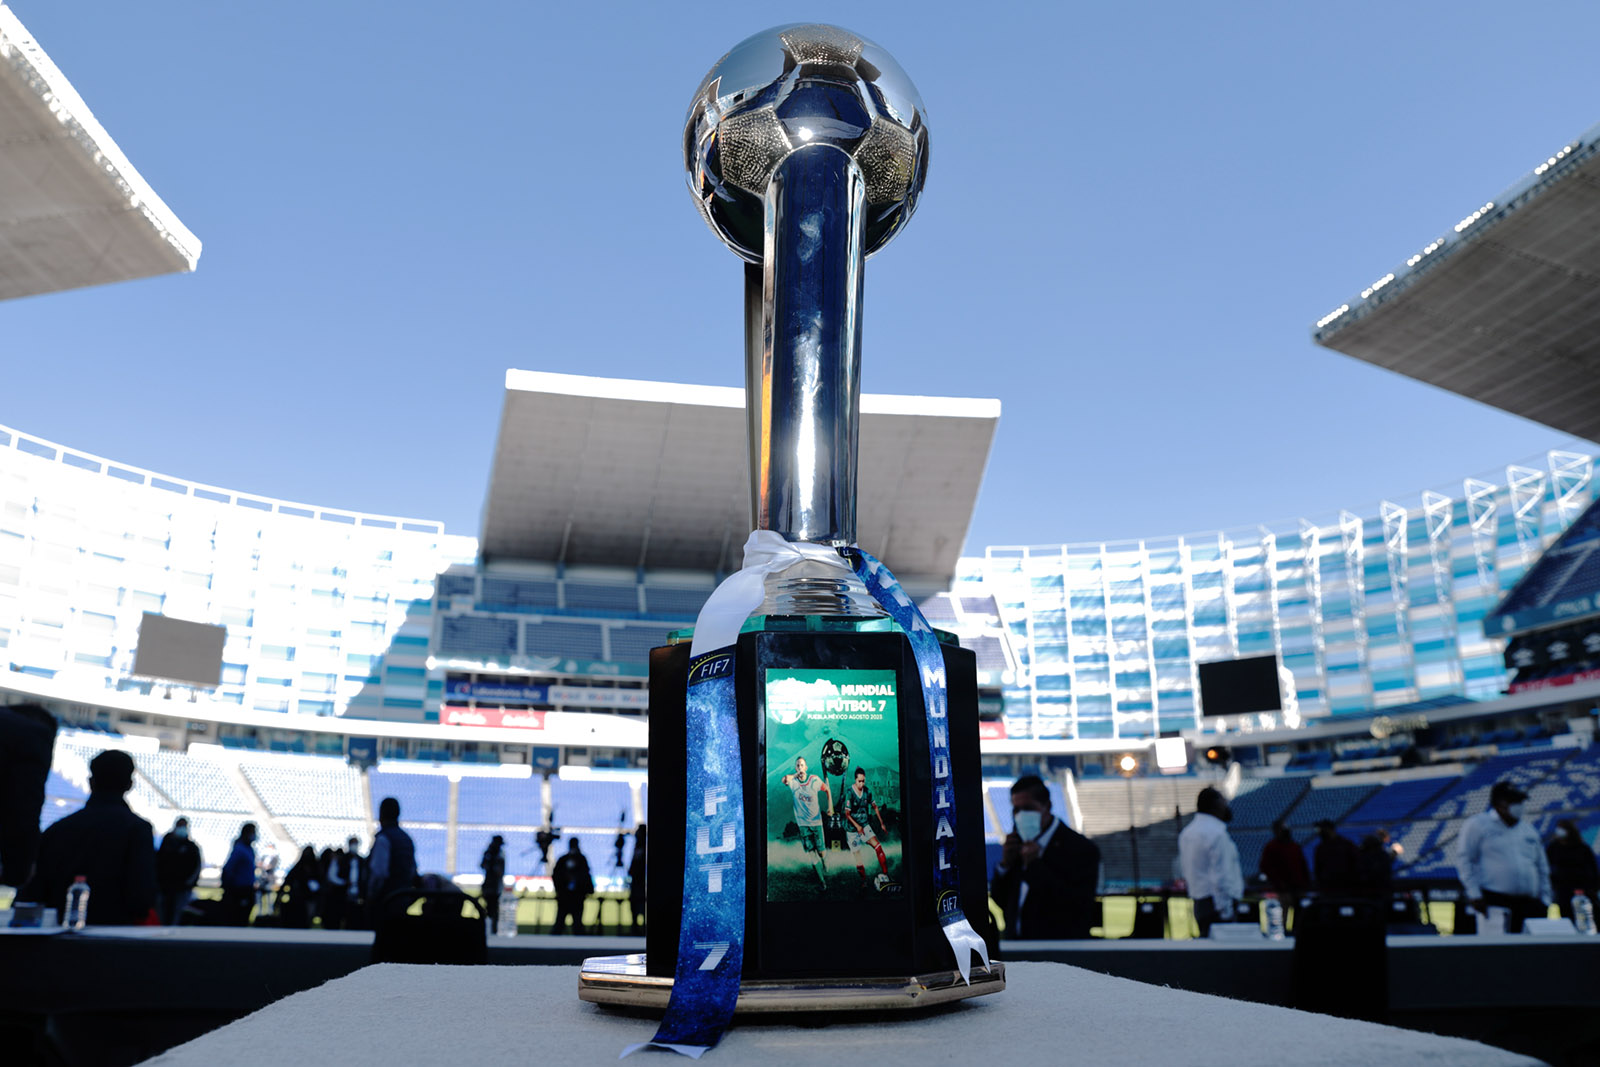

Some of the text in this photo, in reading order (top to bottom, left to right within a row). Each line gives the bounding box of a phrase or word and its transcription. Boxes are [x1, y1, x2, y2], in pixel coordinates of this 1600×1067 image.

[701, 658, 730, 677] FIF7
[841, 684, 895, 696] MUNDIAL
[826, 697, 876, 712] FÚTBOL
[878, 700, 887, 712] 7
[922, 665, 955, 871] MUNDIAL
[694, 785, 736, 971] FUT 7
[942, 896, 958, 913] FIF7
